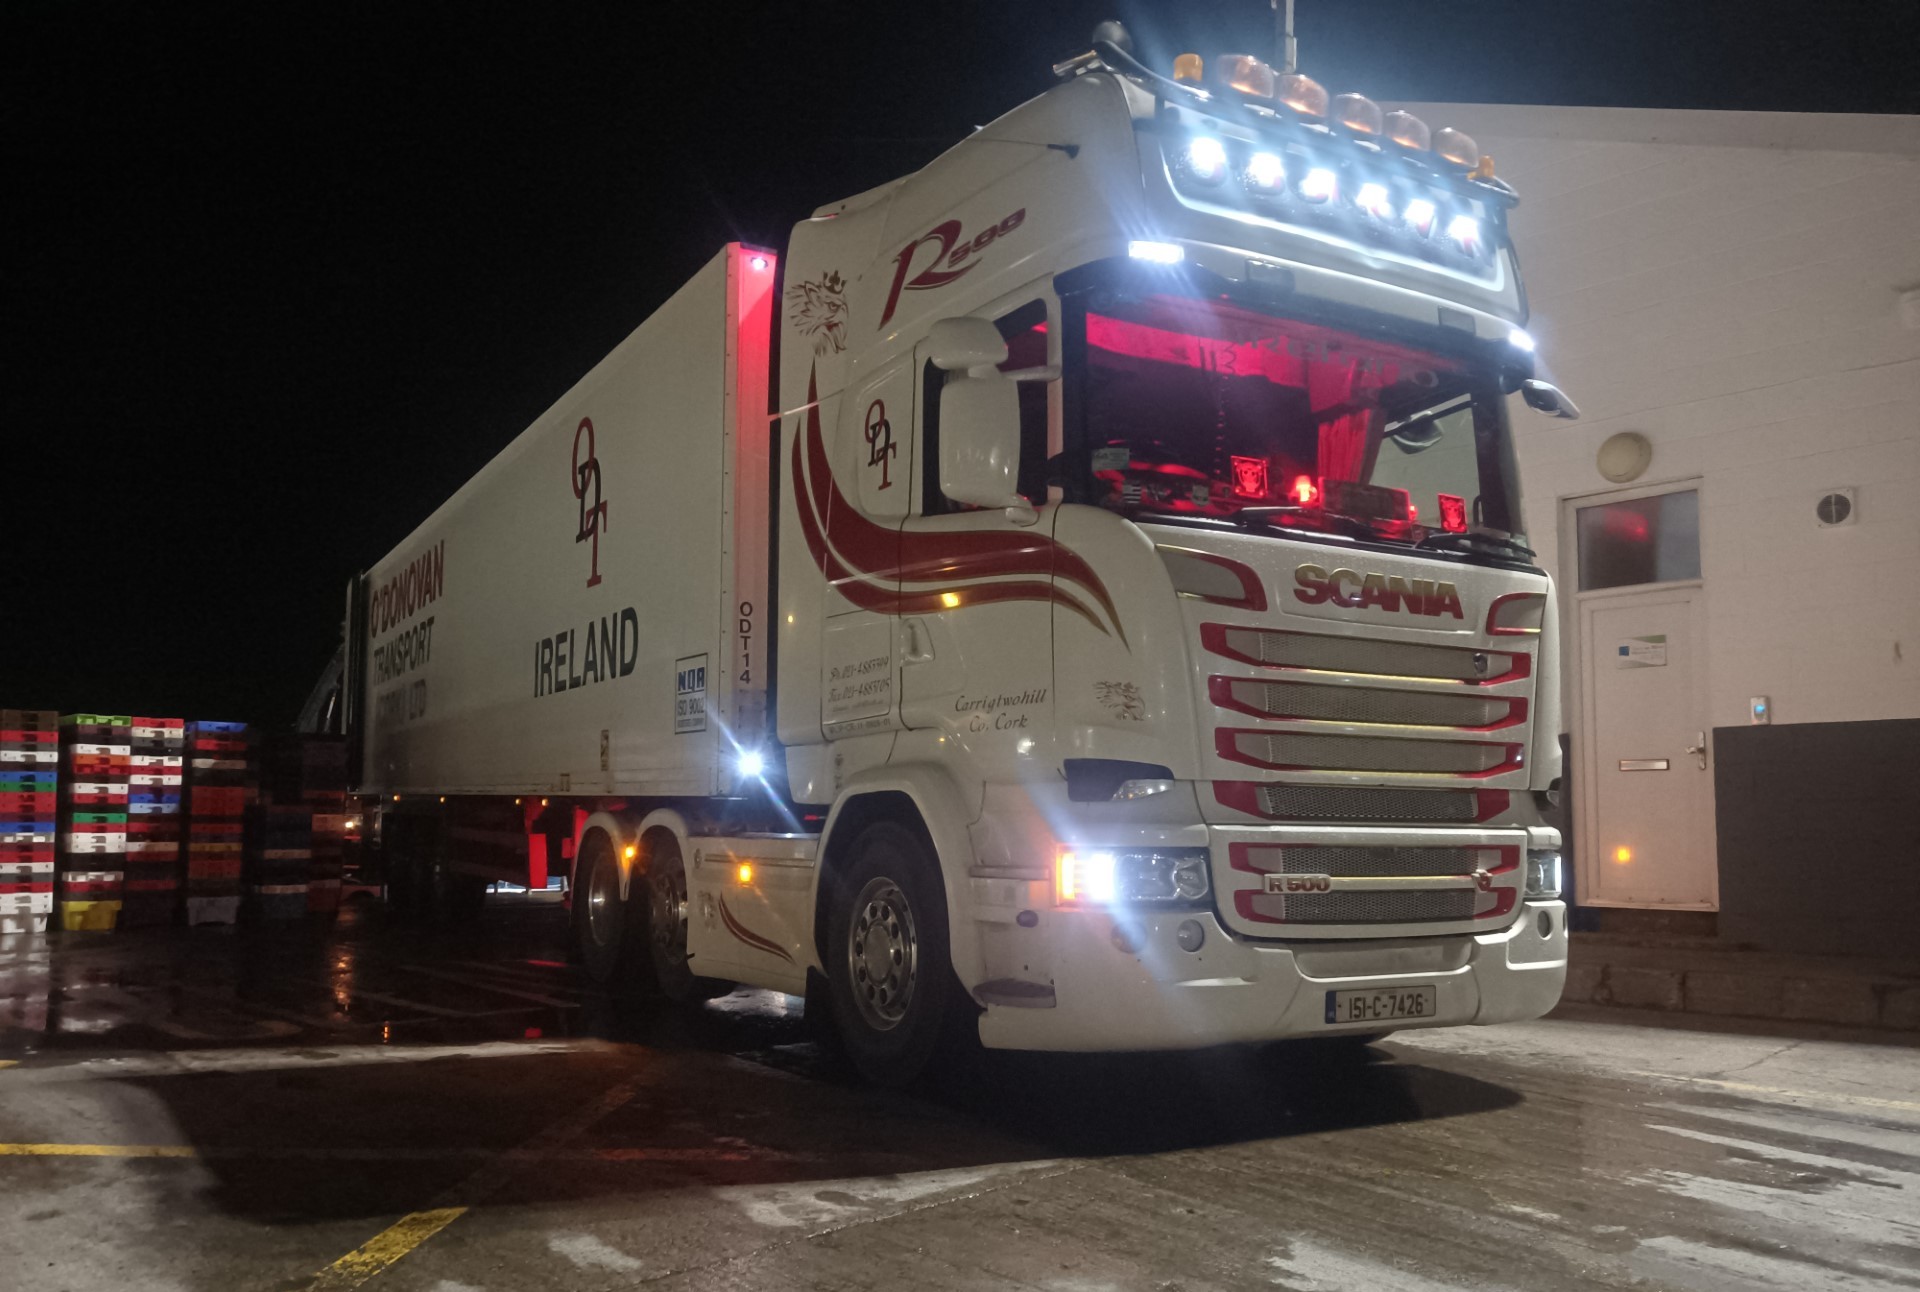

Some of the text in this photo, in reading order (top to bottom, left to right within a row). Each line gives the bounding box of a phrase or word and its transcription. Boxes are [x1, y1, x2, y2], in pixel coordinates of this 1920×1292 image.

[370, 539, 445, 639] O'DONOVAN
[1292, 563, 1465, 620] SCANIA
[373, 615, 435, 686] TRANSPORT
[533, 606, 640, 699] IRELAND
[677, 666, 705, 692] NQA
[954, 688, 1048, 714] Carrigtwohill
[994, 714, 1029, 731] Cork
[1286, 874, 1331, 892] 500
[1349, 993, 1424, 1019] 151-C-7426
